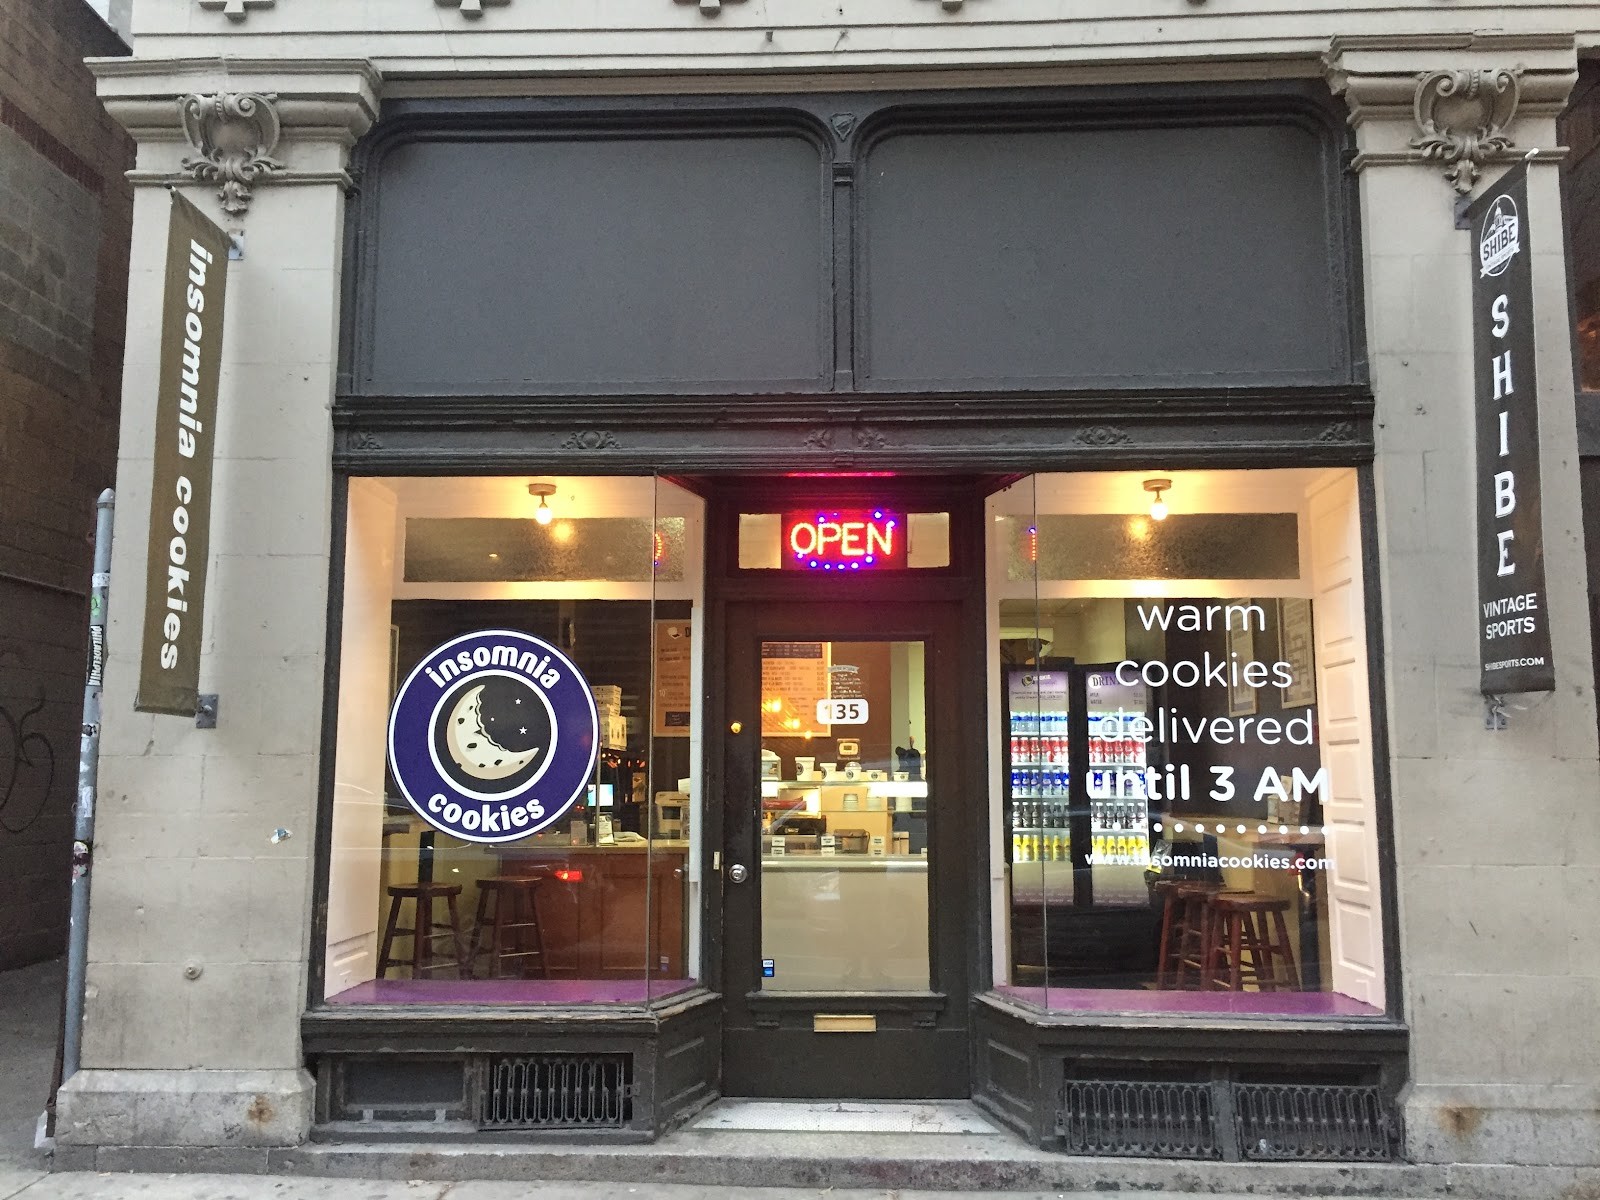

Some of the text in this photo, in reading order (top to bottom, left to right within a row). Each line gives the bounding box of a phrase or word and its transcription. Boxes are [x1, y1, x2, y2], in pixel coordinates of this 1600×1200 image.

[1483, 222, 1516, 261] SHIBE
[160, 238, 213, 671] insomnia cookies
[1491, 293, 1517, 578] SHIBE
[790, 522, 893, 556] OPEN
[1138, 605, 1265, 632] warm
[1483, 592, 1538, 618] VINTAGE
[1486, 616, 1536, 640] SPORTS
[87, 625, 103, 686] PHILADELPHIA
[425, 644, 561, 689] insomnia
[1115, 651, 1293, 688] cookies
[1484, 656, 1545, 672] SHIBESPORTS.COM
[1092, 675, 1122, 687] DRIN
[824, 703, 860, 720] 135
[1100, 706, 1313, 745] delivered
[1085, 764, 1329, 803] until 3 AM
[428, 792, 545, 832] cookies
